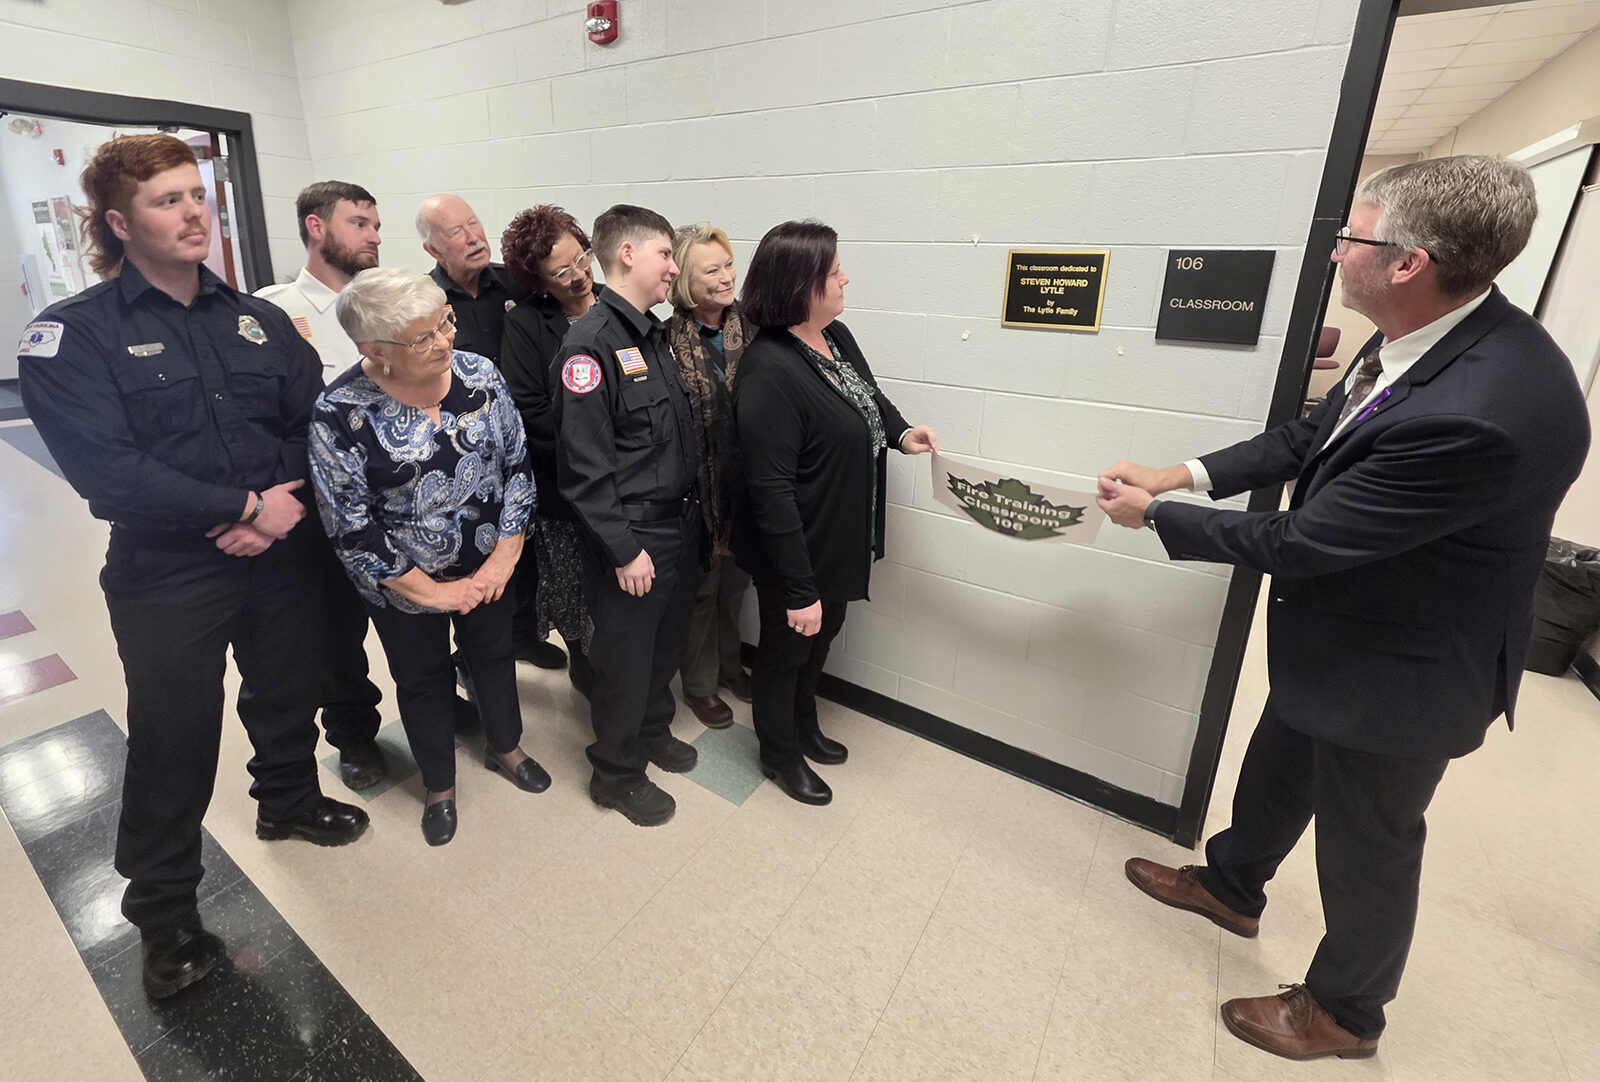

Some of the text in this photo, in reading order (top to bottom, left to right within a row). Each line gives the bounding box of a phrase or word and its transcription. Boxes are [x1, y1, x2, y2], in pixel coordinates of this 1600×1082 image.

[1176, 257, 1204, 270] 106
[1020, 278, 1088, 287] STEVEN HOWARD
[1040, 286, 1064, 294] LYTLE
[1046, 299, 1055, 307] by
[1170, 298, 1254, 311] CLASSROOM
[1023, 305, 1078, 317] The Lytle Family
[957, 481, 1071, 519] Fire Training
[963, 495, 1060, 528] Classroom
[993, 515, 1024, 532] 106
